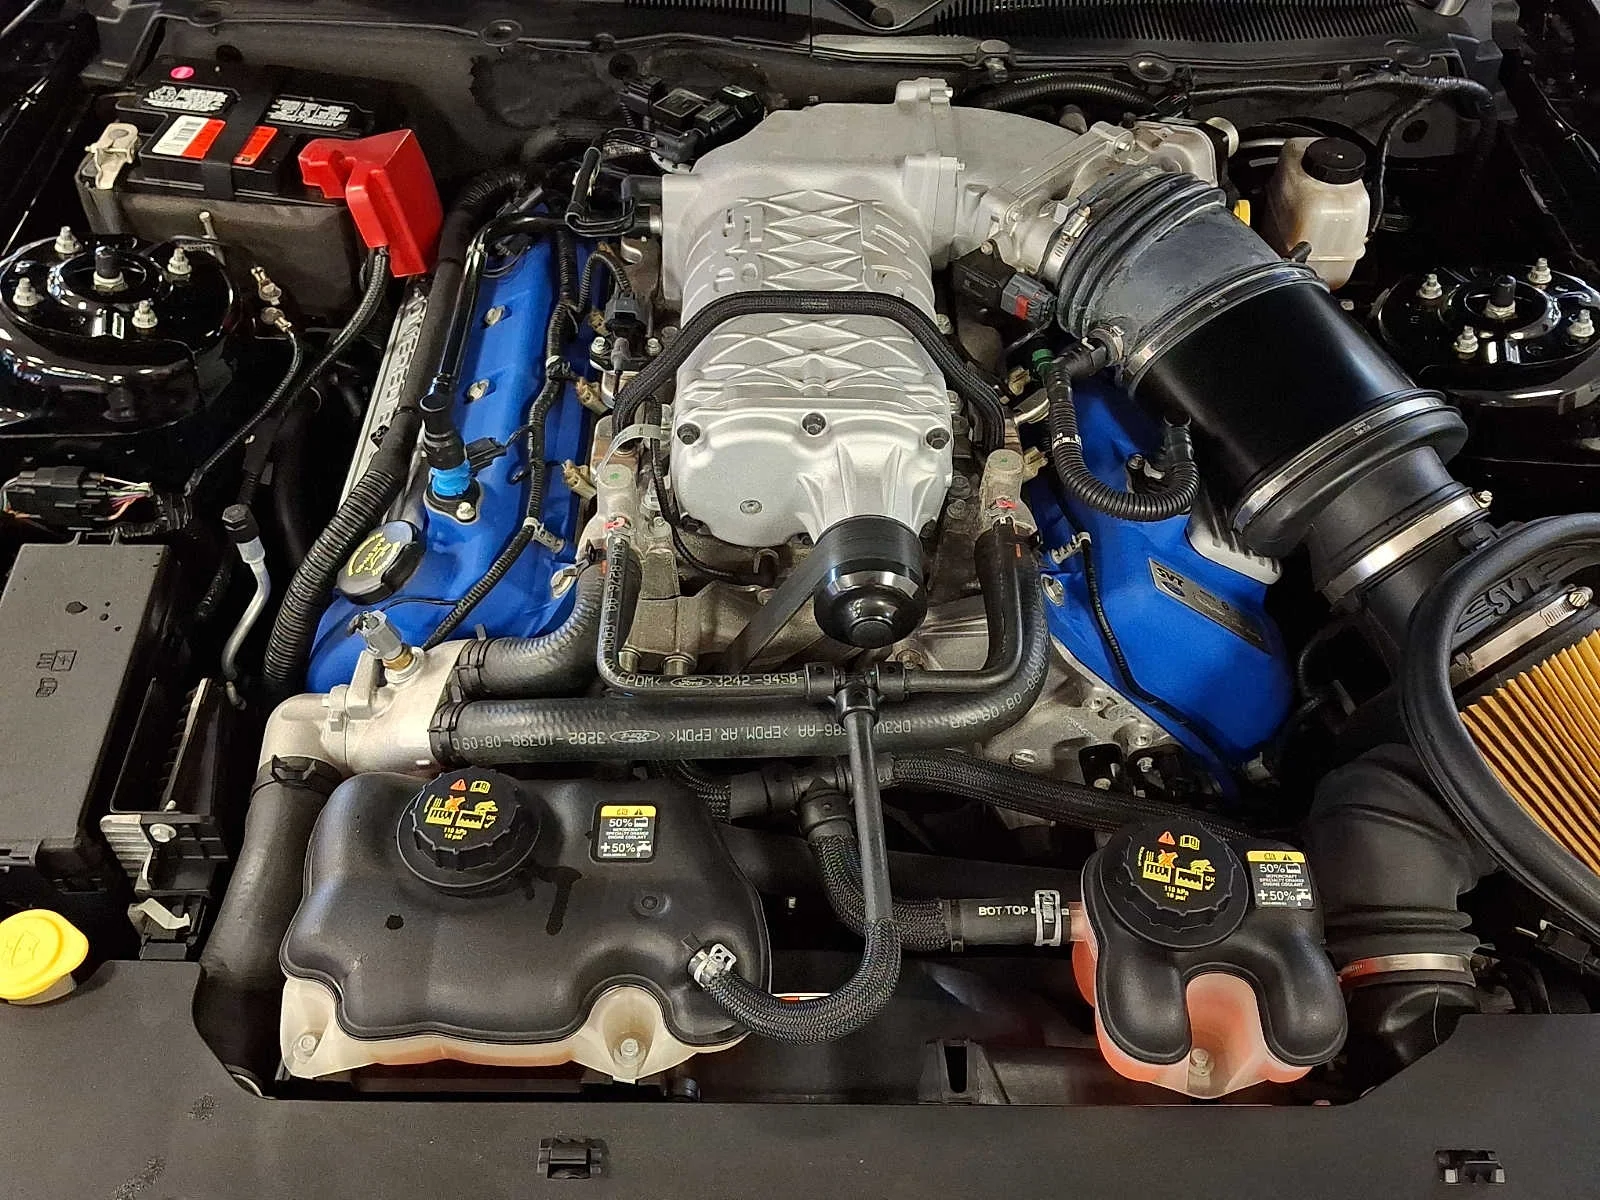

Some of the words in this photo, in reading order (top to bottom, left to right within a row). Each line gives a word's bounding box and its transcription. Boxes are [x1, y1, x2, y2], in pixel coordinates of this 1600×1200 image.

[1157, 568, 1184, 587] SVT
[1488, 568, 1542, 614] SVT
[608, 818, 633, 828] 50%
[1260, 863, 1286, 873] 50%
[978, 906, 1002, 916] BOT
[1004, 905, 1029, 916] TOP
